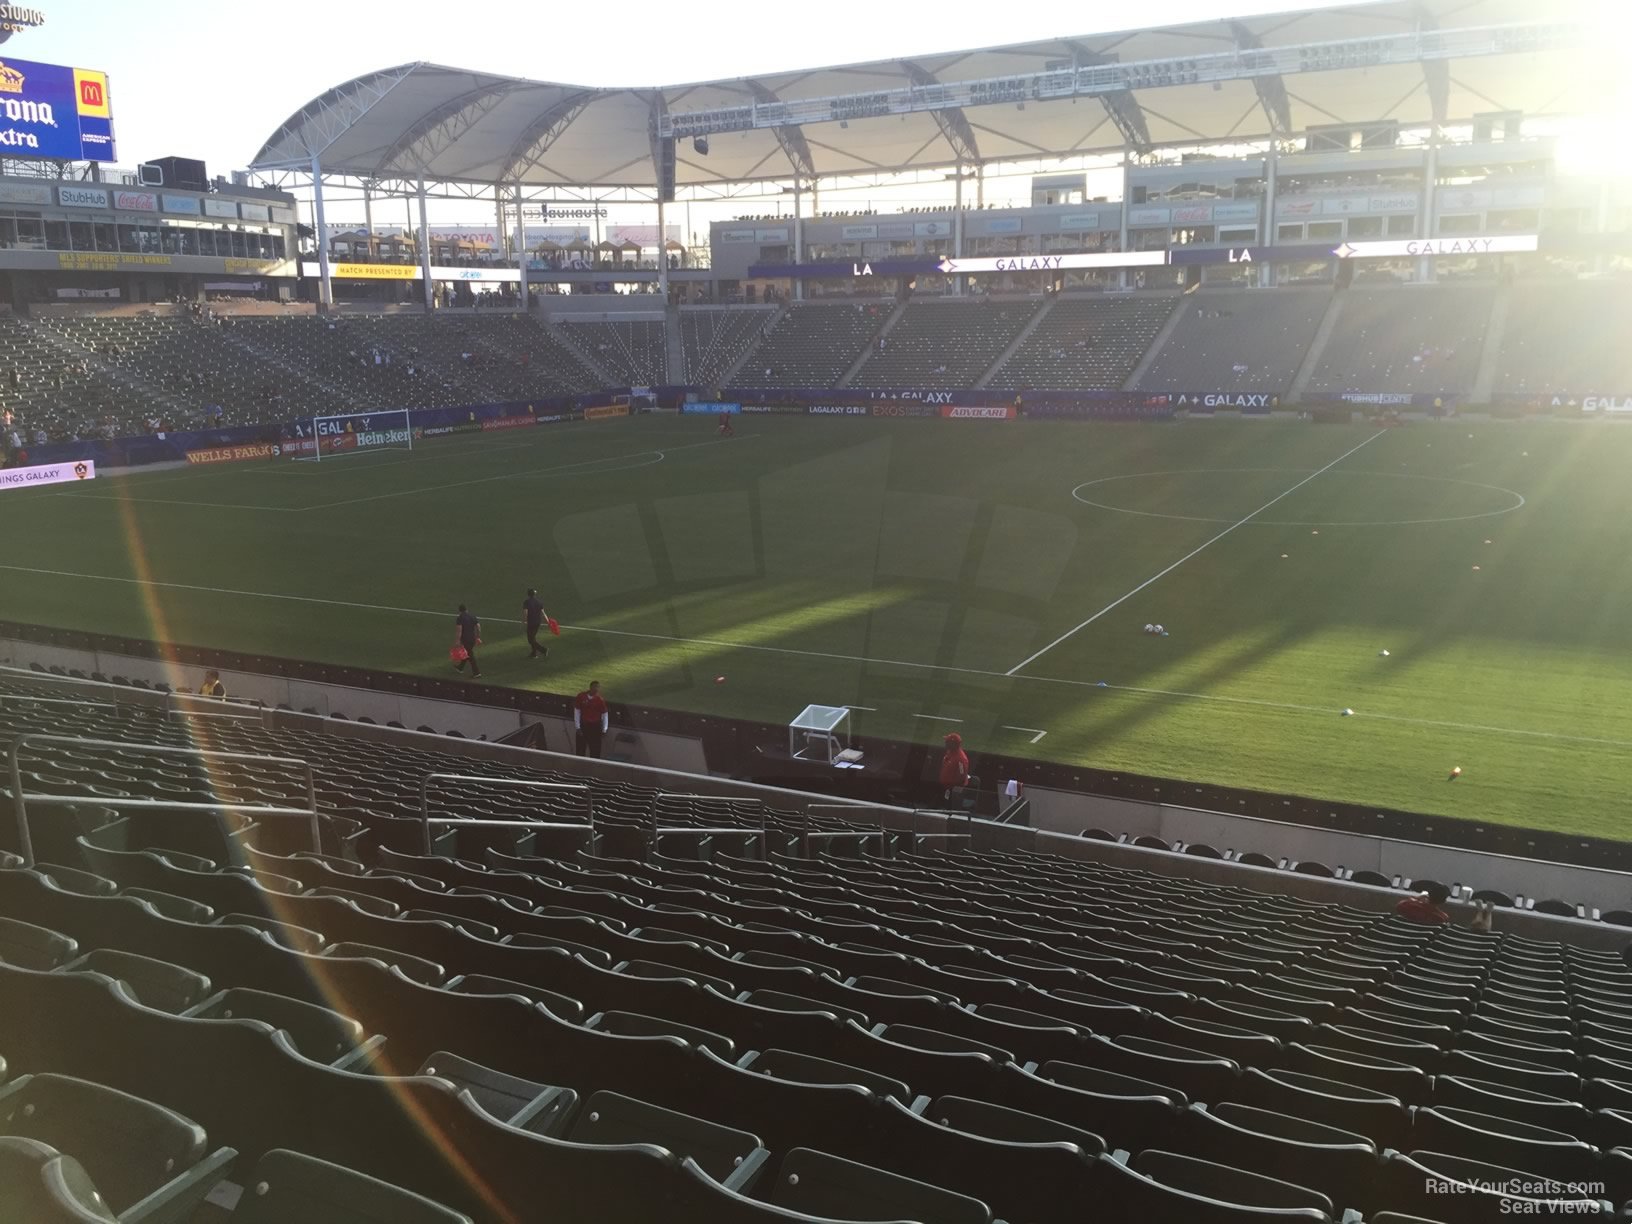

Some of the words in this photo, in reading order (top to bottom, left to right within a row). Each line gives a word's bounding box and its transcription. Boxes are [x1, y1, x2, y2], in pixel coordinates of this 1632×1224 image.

[0, 23, 26, 32] OOD
[61, 190, 105, 205] StubHub
[443, 233, 495, 243] TOYOTA
[1229, 248, 1252, 262] LA
[1407, 240, 1492, 255] GALAXY
[853, 263, 873, 276] LA
[996, 256, 1063, 271] GALAXY
[339, 267, 363, 275] MATCH
[365, 267, 400, 277] PRESENTED
[1204, 395, 1270, 406] GALAXY
[809, 406, 844, 414] LAGALAXY
[872, 406, 906, 416] EXOS
[951, 408, 1007, 417] ADVOCARE
[357, 430, 409, 447] Heineken
[187, 449, 232, 463] WELLS
[26, 470, 60, 480] GALAXY
